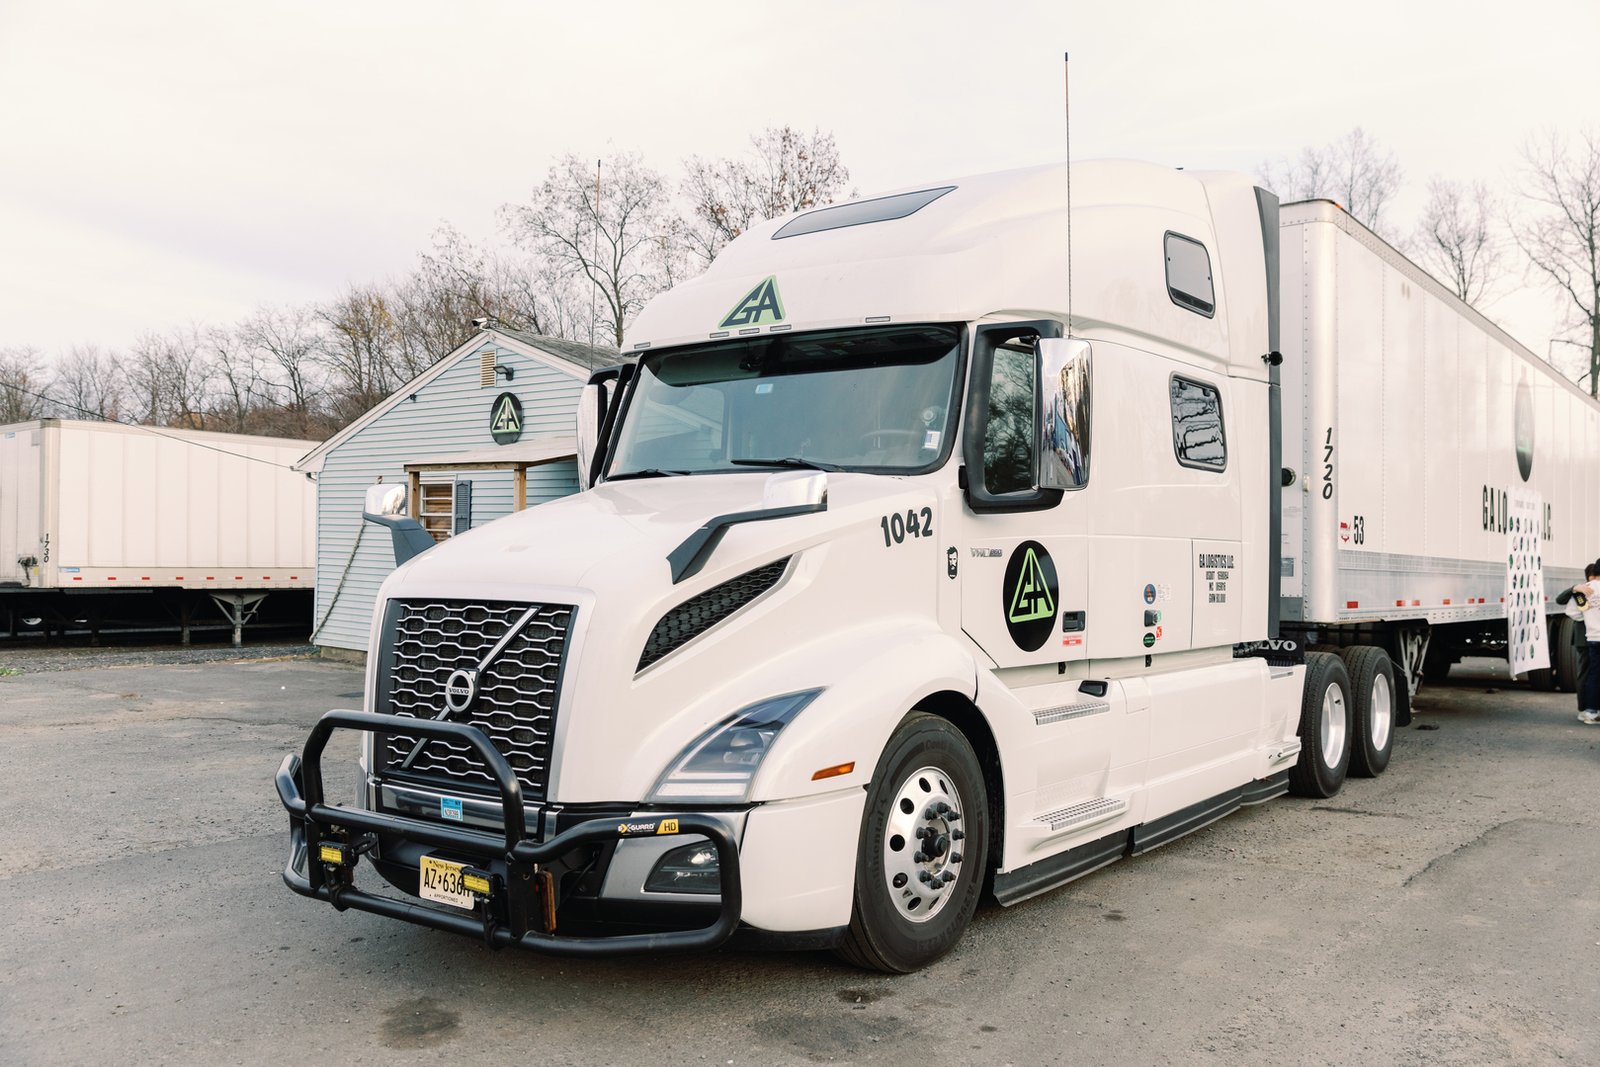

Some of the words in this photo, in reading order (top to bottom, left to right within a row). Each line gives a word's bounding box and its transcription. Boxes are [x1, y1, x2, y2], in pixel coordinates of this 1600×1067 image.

[720, 277, 782, 327] GA
[493, 399, 519, 430] GA
[1322, 426, 1334, 500] 1720
[881, 506, 933, 548] 1042
[1353, 515, 1365, 545] 53
[1199, 554, 1205, 568] GA
[1206, 554, 1227, 568] LOGISTICS
[1012, 554, 1053, 617] GA
[1258, 639, 1297, 651] LVO
[448, 687, 469, 695] VOLVO
[664, 822, 676, 831] HD
[433, 860, 444, 868] New
[443, 873, 470, 897] 636
[434, 893, 459, 903] APPORTIONED
